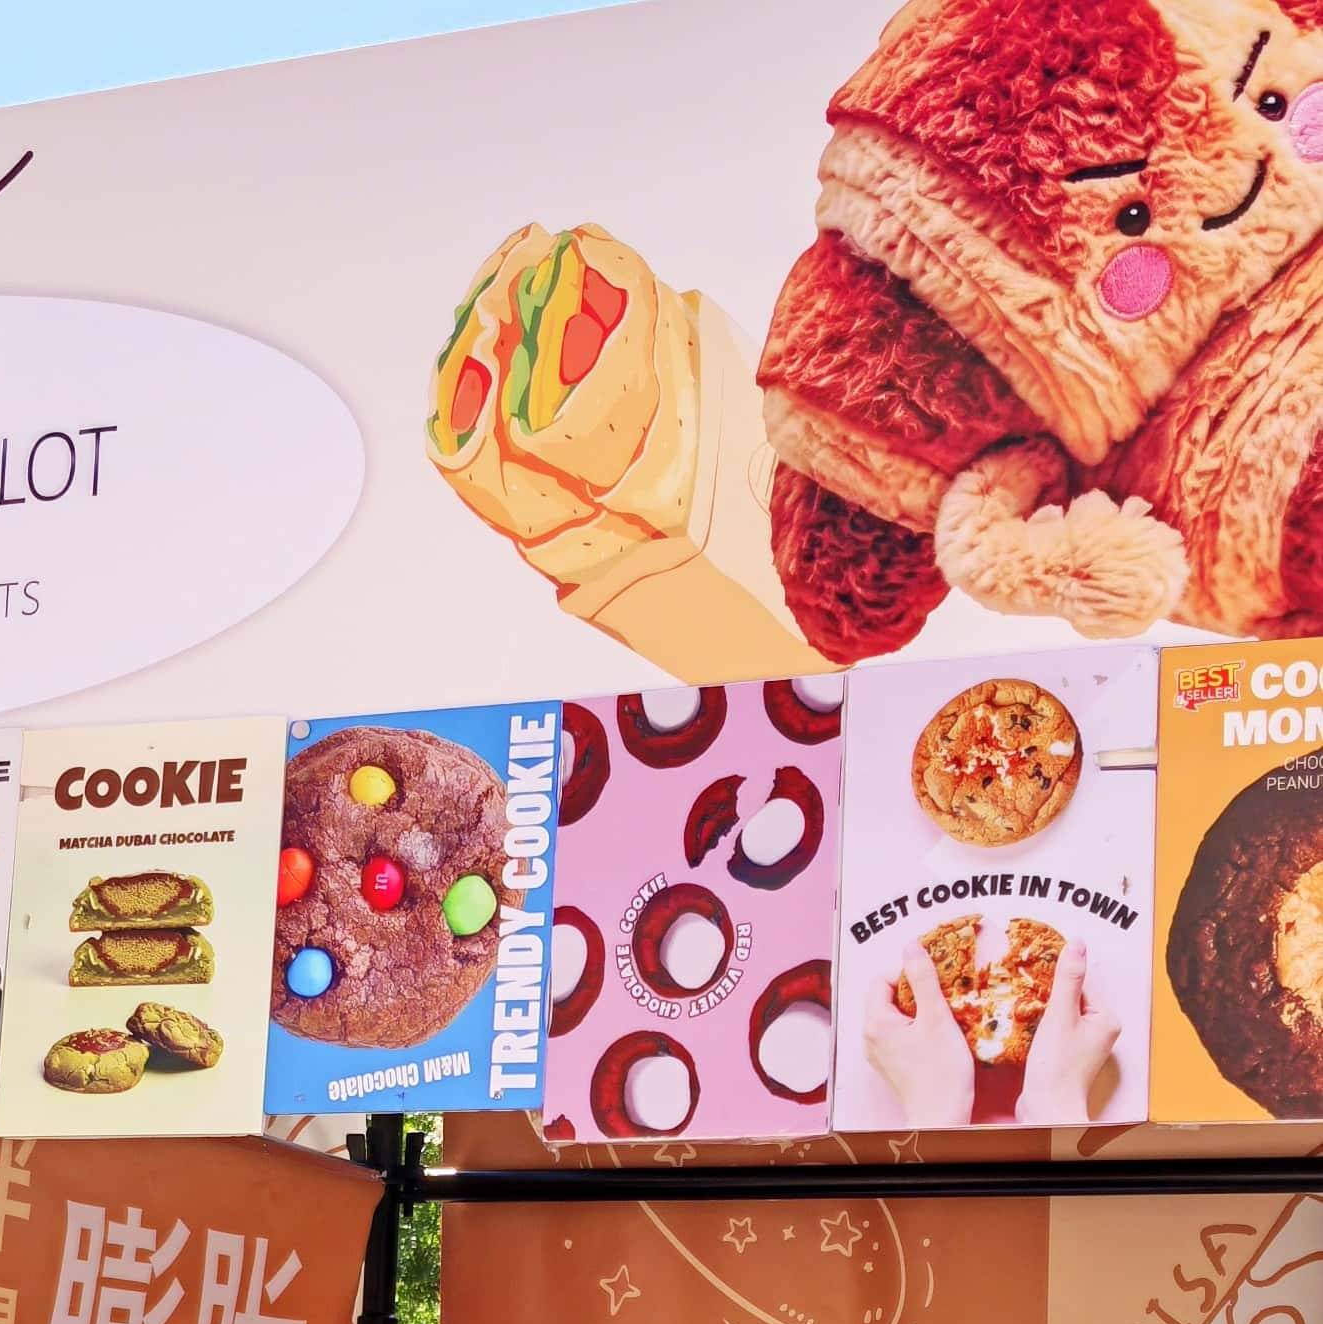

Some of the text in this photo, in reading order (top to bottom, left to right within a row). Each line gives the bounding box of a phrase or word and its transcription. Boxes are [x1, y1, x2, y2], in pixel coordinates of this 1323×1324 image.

[1179, 662, 1240, 690] BEST
[1186, 683, 1238, 701] SELLER!
[1250, 660, 1323, 700] CO
[54, 758, 248, 811] COOKIE
[58, 830, 235, 850] MATCHA DUBAI CHOCOLATE
[489, 712, 557, 1100] TRENDY COOKIE
[849, 873, 1139, 945] BEST COOKIE IN TOWN
[615, 872, 753, 1020] RED VELVET CHOCOLATE COOKIE
[328, 1050, 471, 1101] M&M Chocolate
